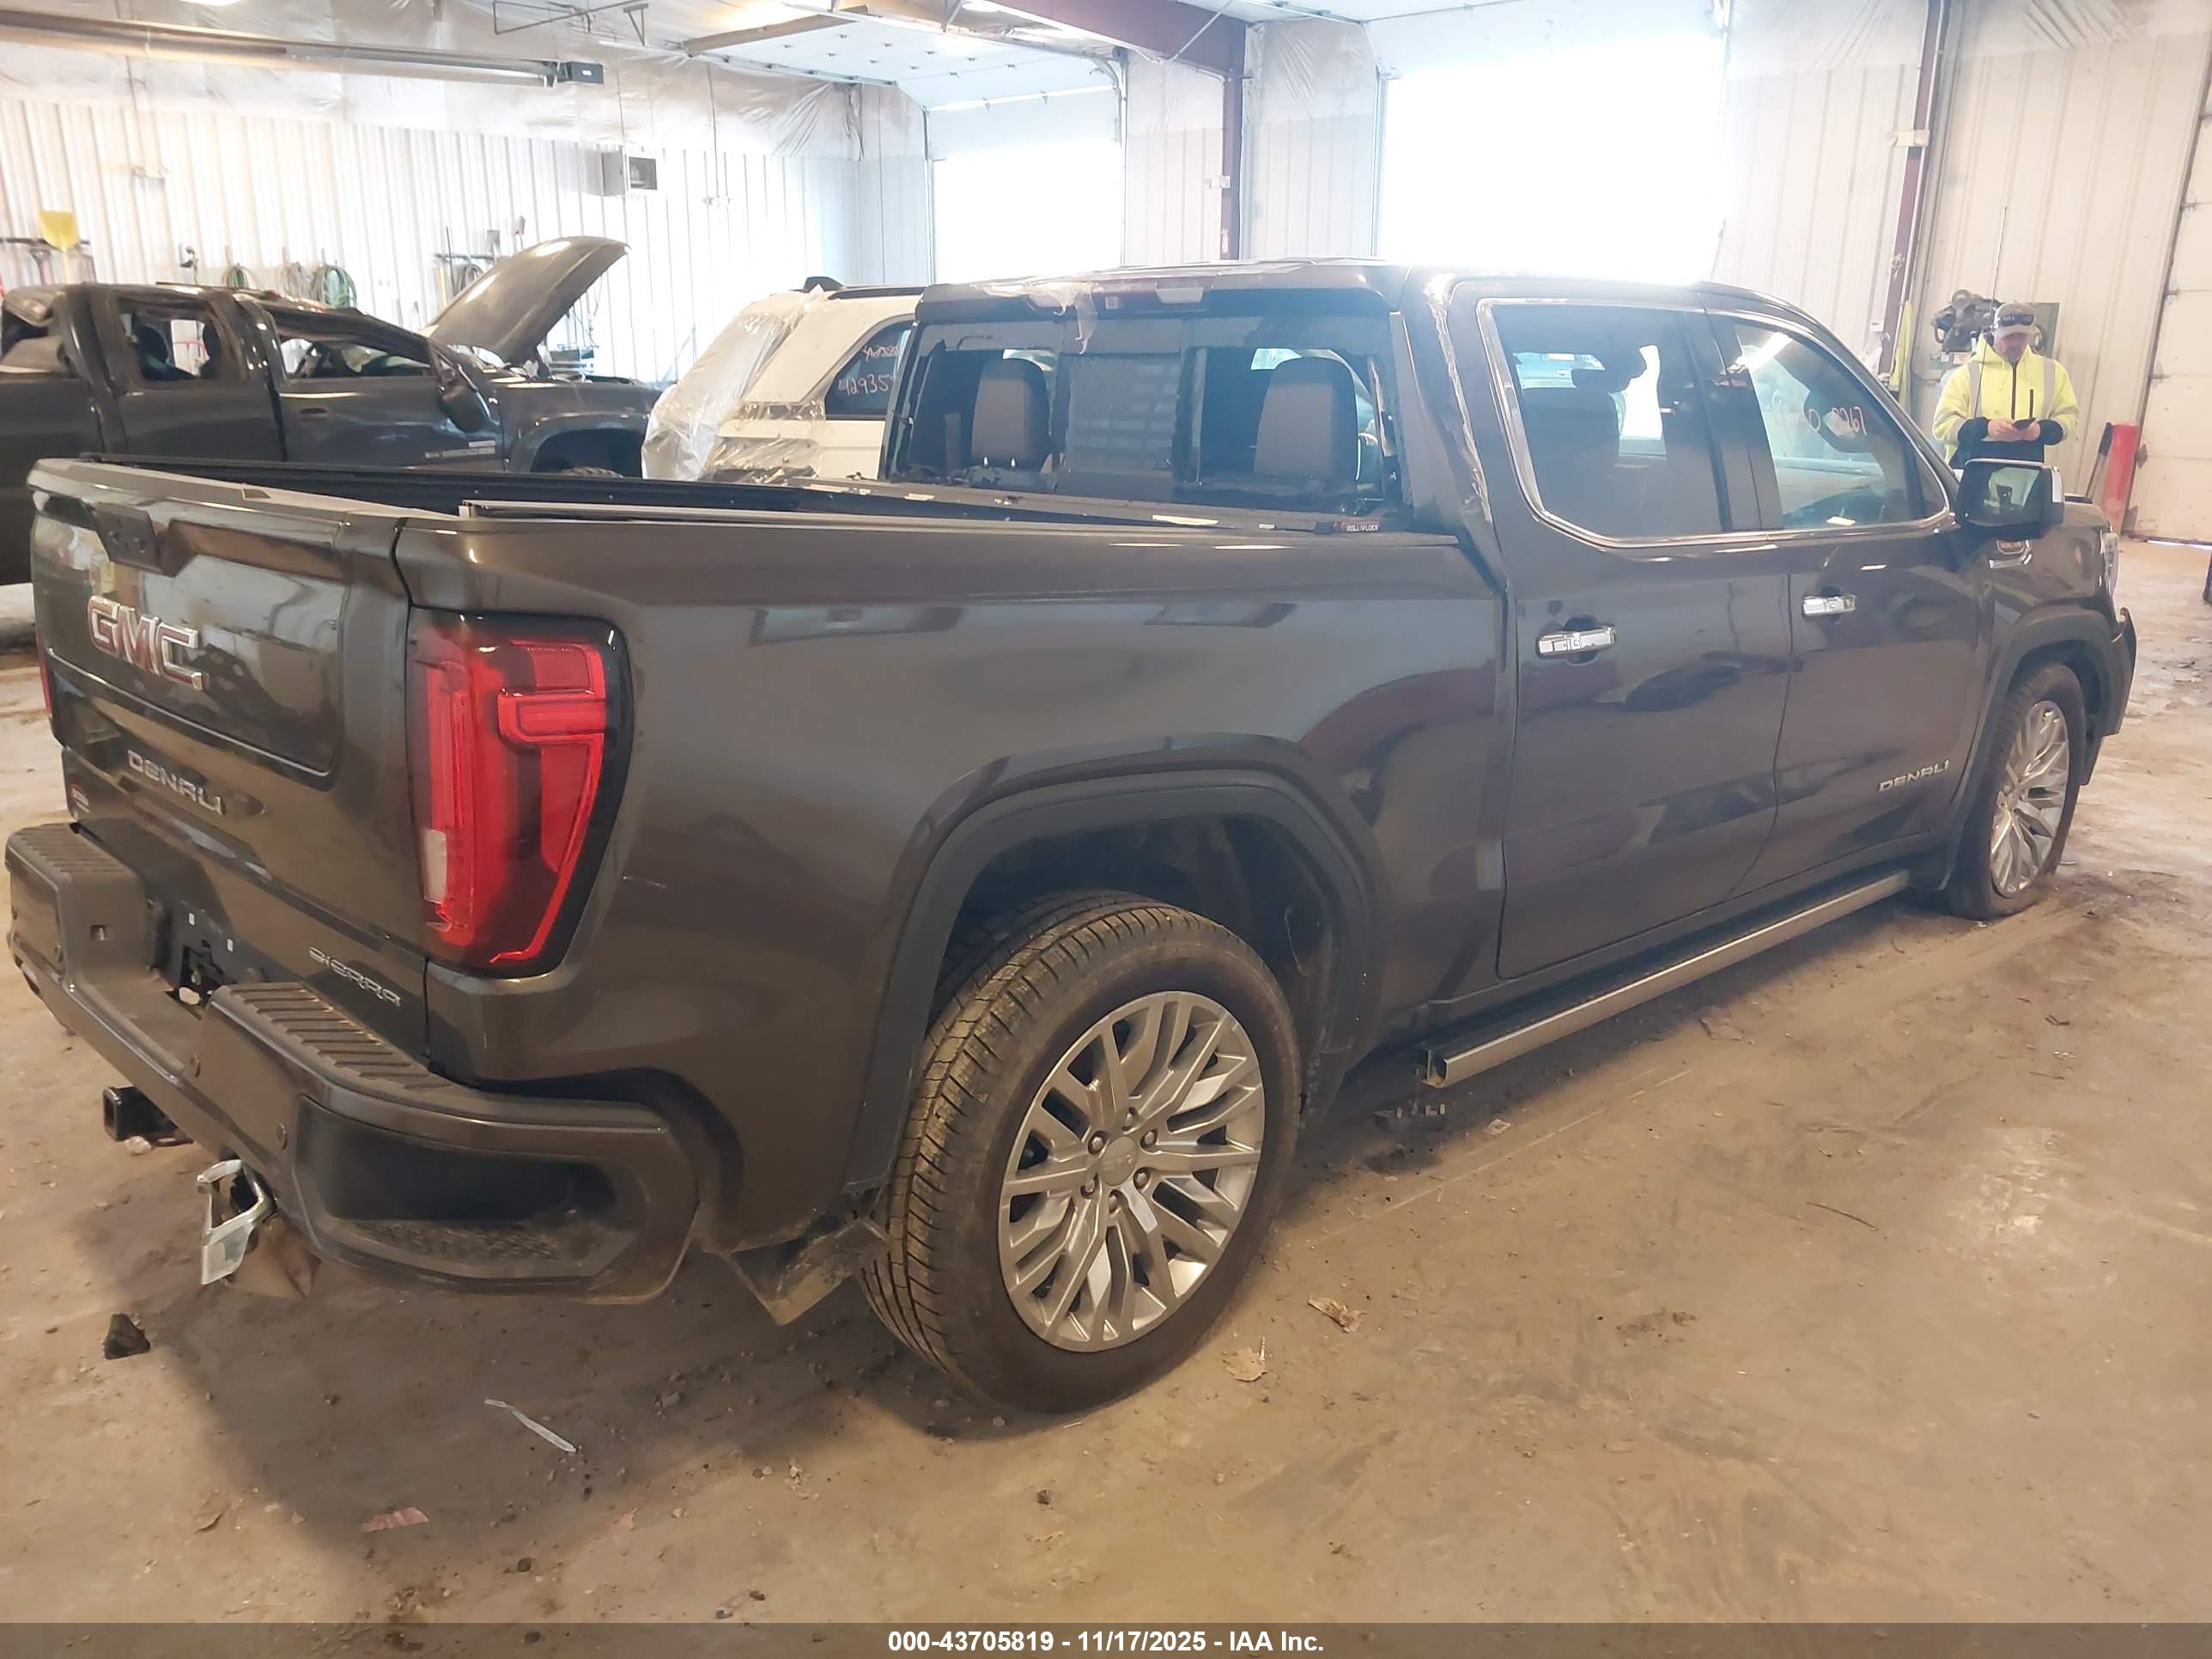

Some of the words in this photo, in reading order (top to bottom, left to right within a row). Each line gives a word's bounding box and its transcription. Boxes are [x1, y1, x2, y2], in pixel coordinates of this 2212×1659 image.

[88, 595, 203, 690] GMC
[127, 750, 222, 815] DENALI
[1877, 759, 1949, 793] DENALI
[309, 946, 401, 1007] SIERRA
